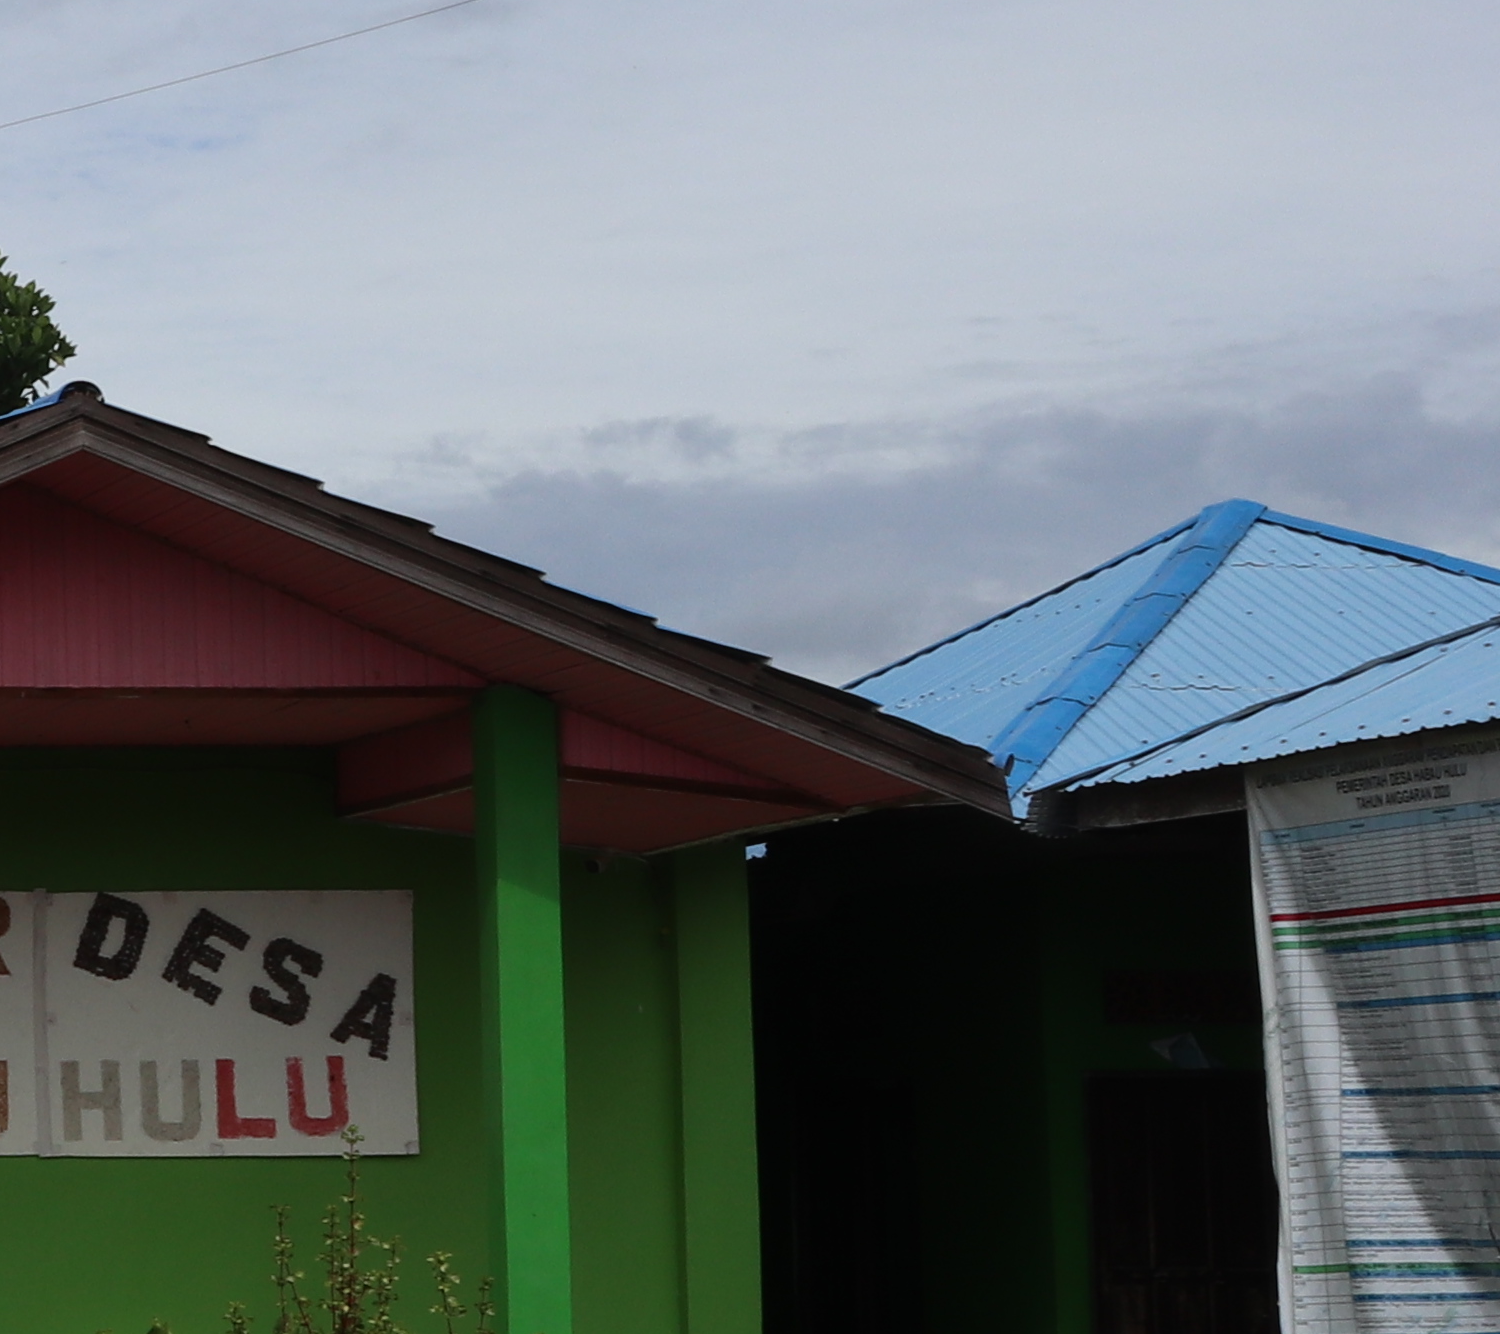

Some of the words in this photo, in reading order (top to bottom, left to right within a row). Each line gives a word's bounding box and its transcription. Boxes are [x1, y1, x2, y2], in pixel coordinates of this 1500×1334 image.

[1336, 776, 1387, 794] PEMERINTAH
[1389, 770, 1412, 786] DESA
[1413, 766, 1441, 782] HABAU
[1444, 763, 1467, 778] HULU
[1356, 793, 1383, 808] TAHUN
[1386, 786, 1432, 804] ANGGARAN
[72, 891, 397, 1061] DESA
[60, 1055, 349, 1143] HULU
